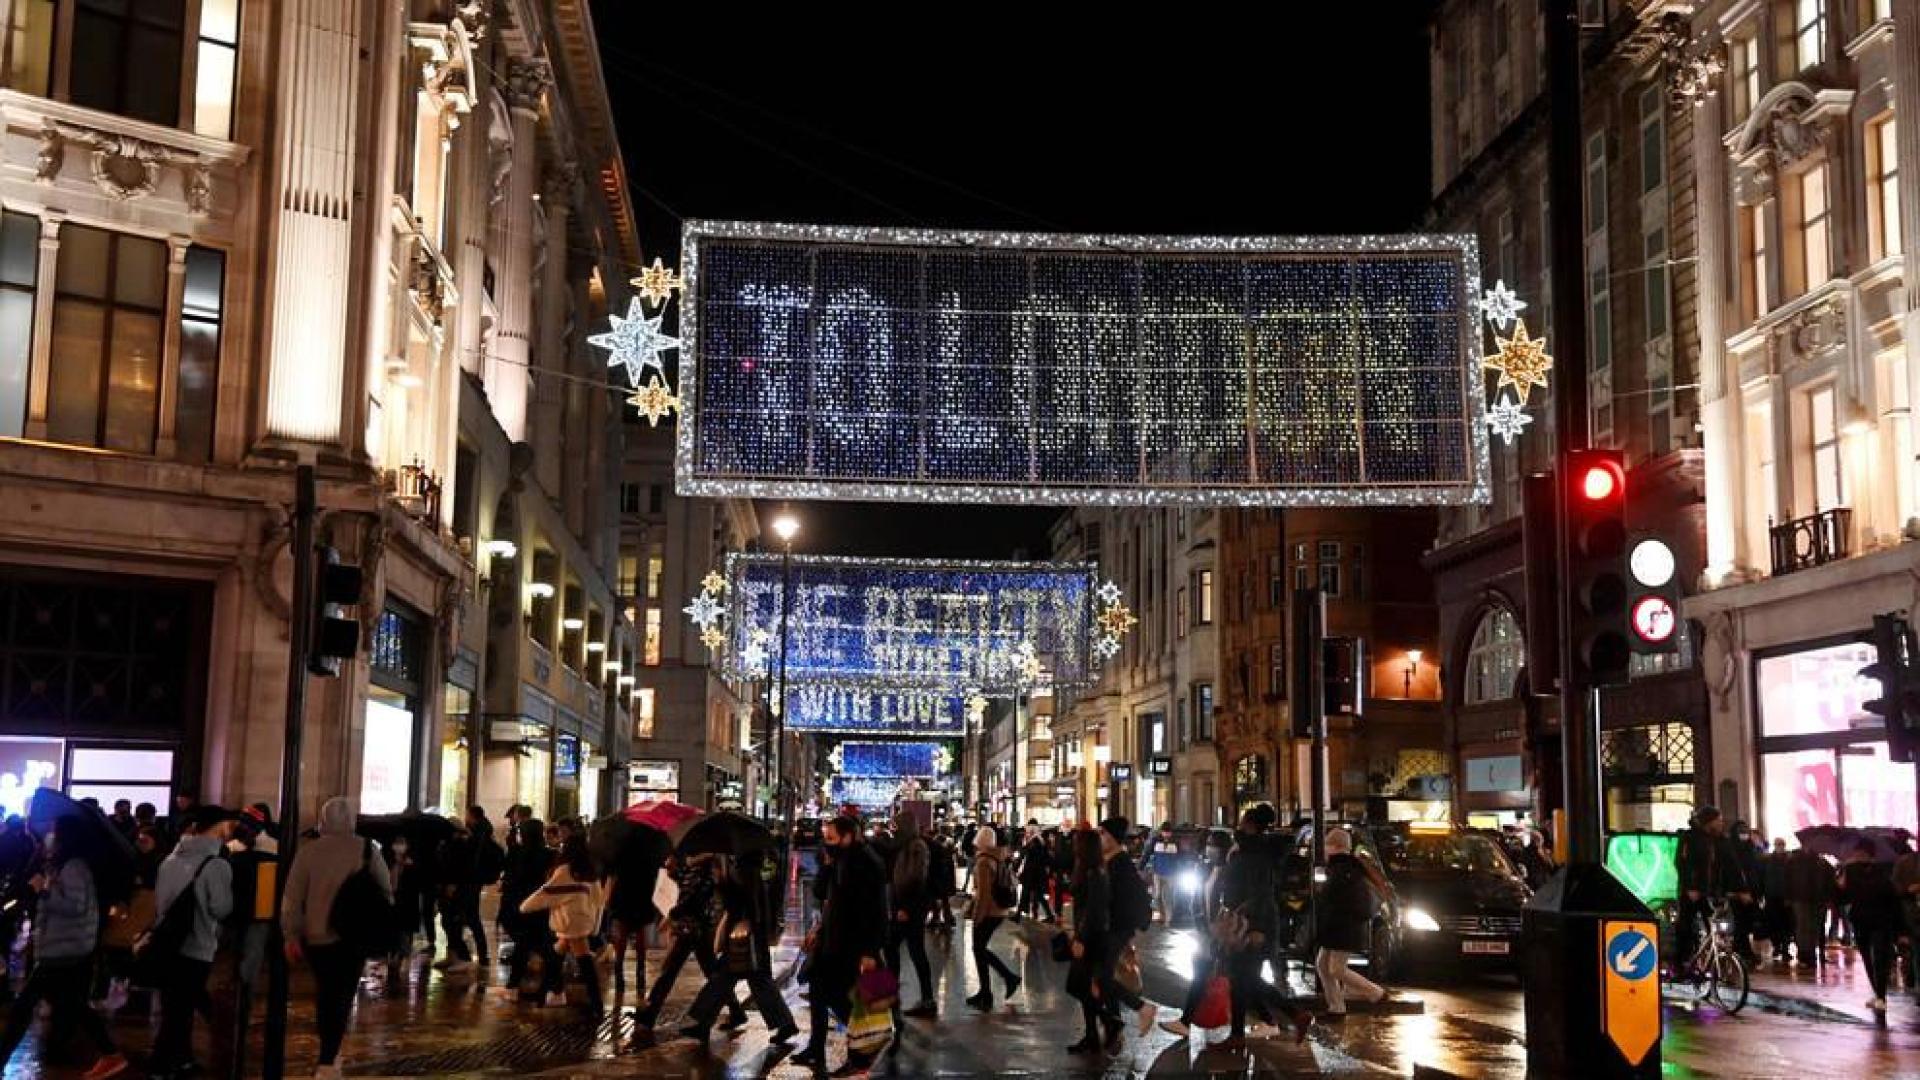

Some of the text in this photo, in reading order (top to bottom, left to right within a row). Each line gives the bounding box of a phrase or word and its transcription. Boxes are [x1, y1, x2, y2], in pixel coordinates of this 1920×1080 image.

[739, 284, 1421, 453] TO LONDON
[881, 690, 952, 723] LOVE
